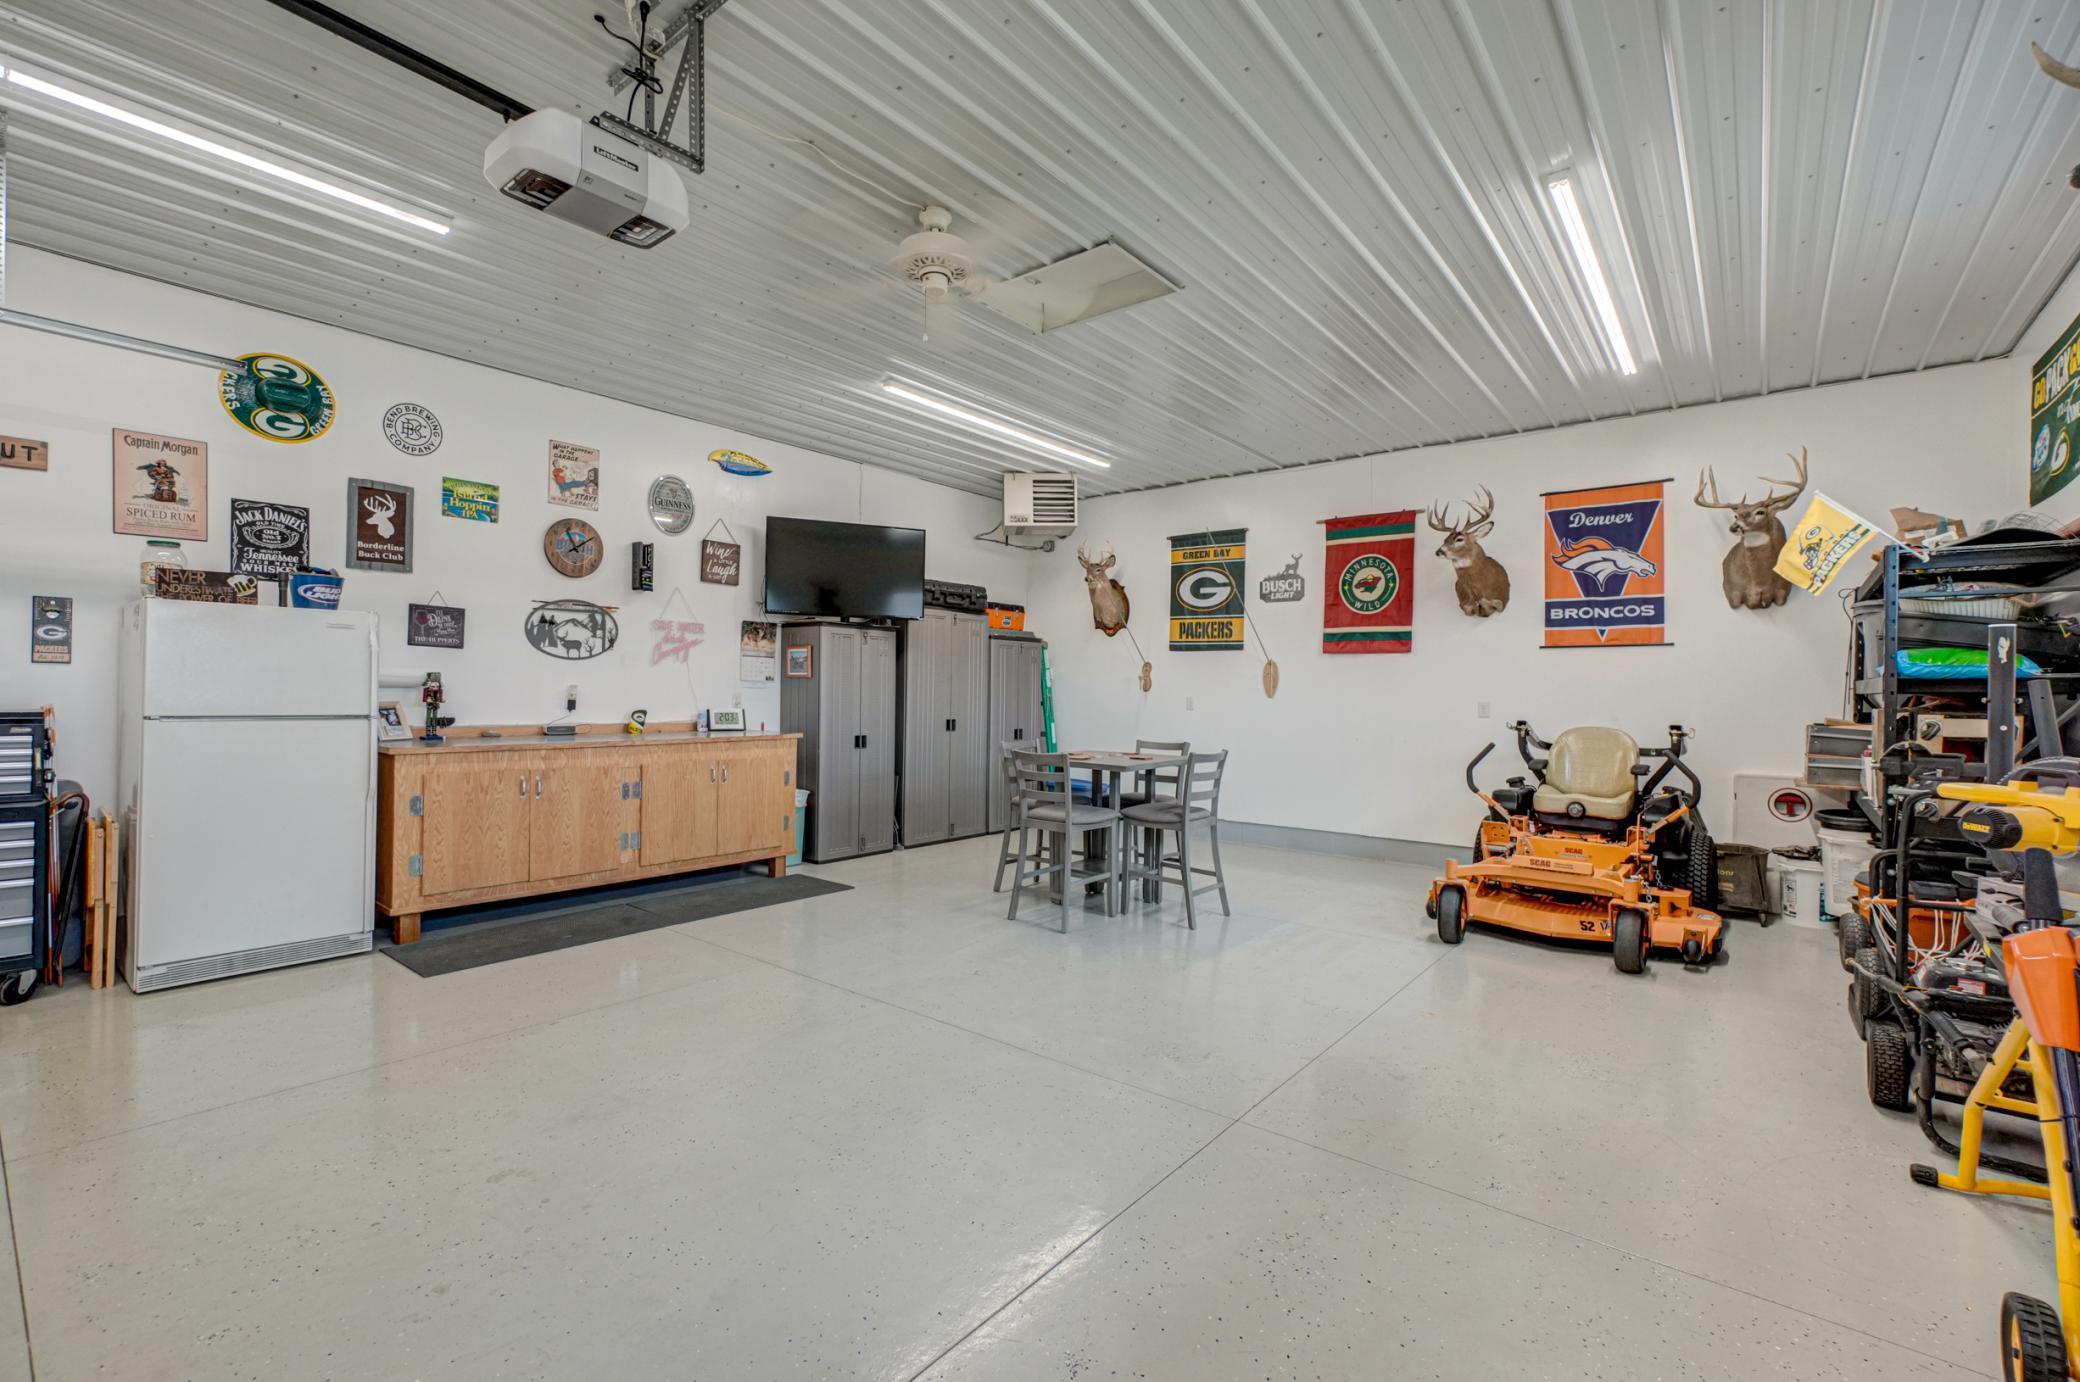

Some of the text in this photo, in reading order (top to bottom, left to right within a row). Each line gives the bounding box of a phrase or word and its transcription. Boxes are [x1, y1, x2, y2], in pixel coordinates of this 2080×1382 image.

[596, 147, 637, 171] LiftMaster
[2033, 376, 2046, 410] GO
[2046, 346, 2071, 403] PACK
[222, 371, 240, 410] CKERS
[310, 384, 334, 435] GREEN BAY
[386, 405, 440, 438] BEND BREWING
[124, 434, 198, 457] Captain Morgan
[389, 433, 436, 453] COMPANY
[553, 453, 579, 462] GARAGE
[575, 493, 598, 502] STAYS
[654, 496, 692, 510] GUINNESS
[126, 507, 196, 523] SPICED RUM
[234, 507, 308, 533] JACK DANIEL'S
[1568, 511, 1635, 528] Denver
[357, 541, 405, 552] Borderline
[706, 541, 737, 559] Wine
[1182, 548, 1231, 560] GREEN BAY
[243, 547, 299, 563] Tennessee
[358, 550, 404, 561] Buck Club
[1812, 530, 1862, 588] PACKERS
[156, 568, 207, 585] NEVER
[706, 559, 738, 584] Laugh
[1344, 558, 1394, 582] MINNESOTA
[157, 583, 234, 596] UNDERESTIMATE
[1262, 578, 1302, 594] BUSCH
[1270, 591, 1295, 600] LIGHT
[1354, 600, 1381, 611] WILD
[1550, 604, 1656, 620] BRONCOS
[1178, 620, 1234, 640] PACKERS
[1529, 858, 1551, 868] SCAG
[1579, 920, 1596, 933] 52
